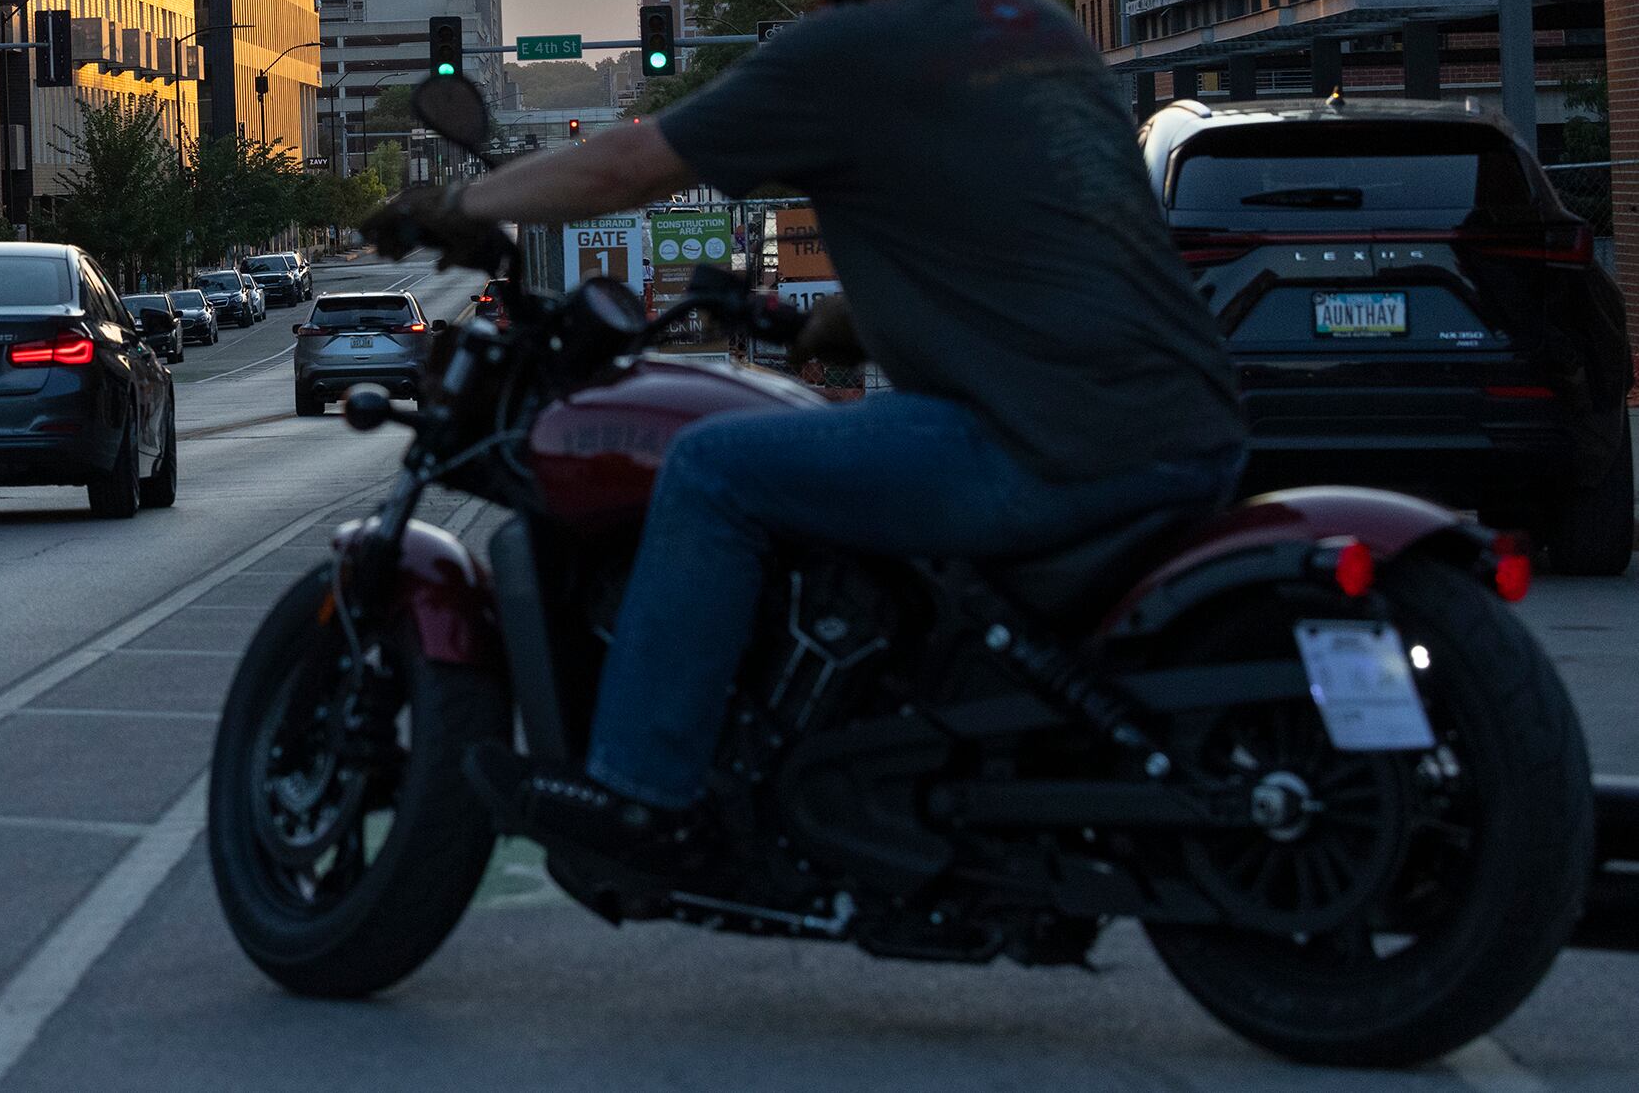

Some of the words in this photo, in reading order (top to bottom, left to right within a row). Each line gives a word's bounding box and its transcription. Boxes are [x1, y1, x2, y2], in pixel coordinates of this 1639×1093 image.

[521, 43, 530, 55] E
[534, 42, 558, 54] 4th
[562, 40, 577, 53] St
[591, 220, 598, 228] E
[598, 219, 632, 228] GRAND
[656, 219, 725, 229] CONSTRUCTION
[577, 230, 628, 246] GATE
[679, 227, 704, 236] AREA
[1295, 250, 1424, 261] LEXUS
[595, 250, 609, 278] 1
[1322, 304, 1397, 325] AUNTHAY
